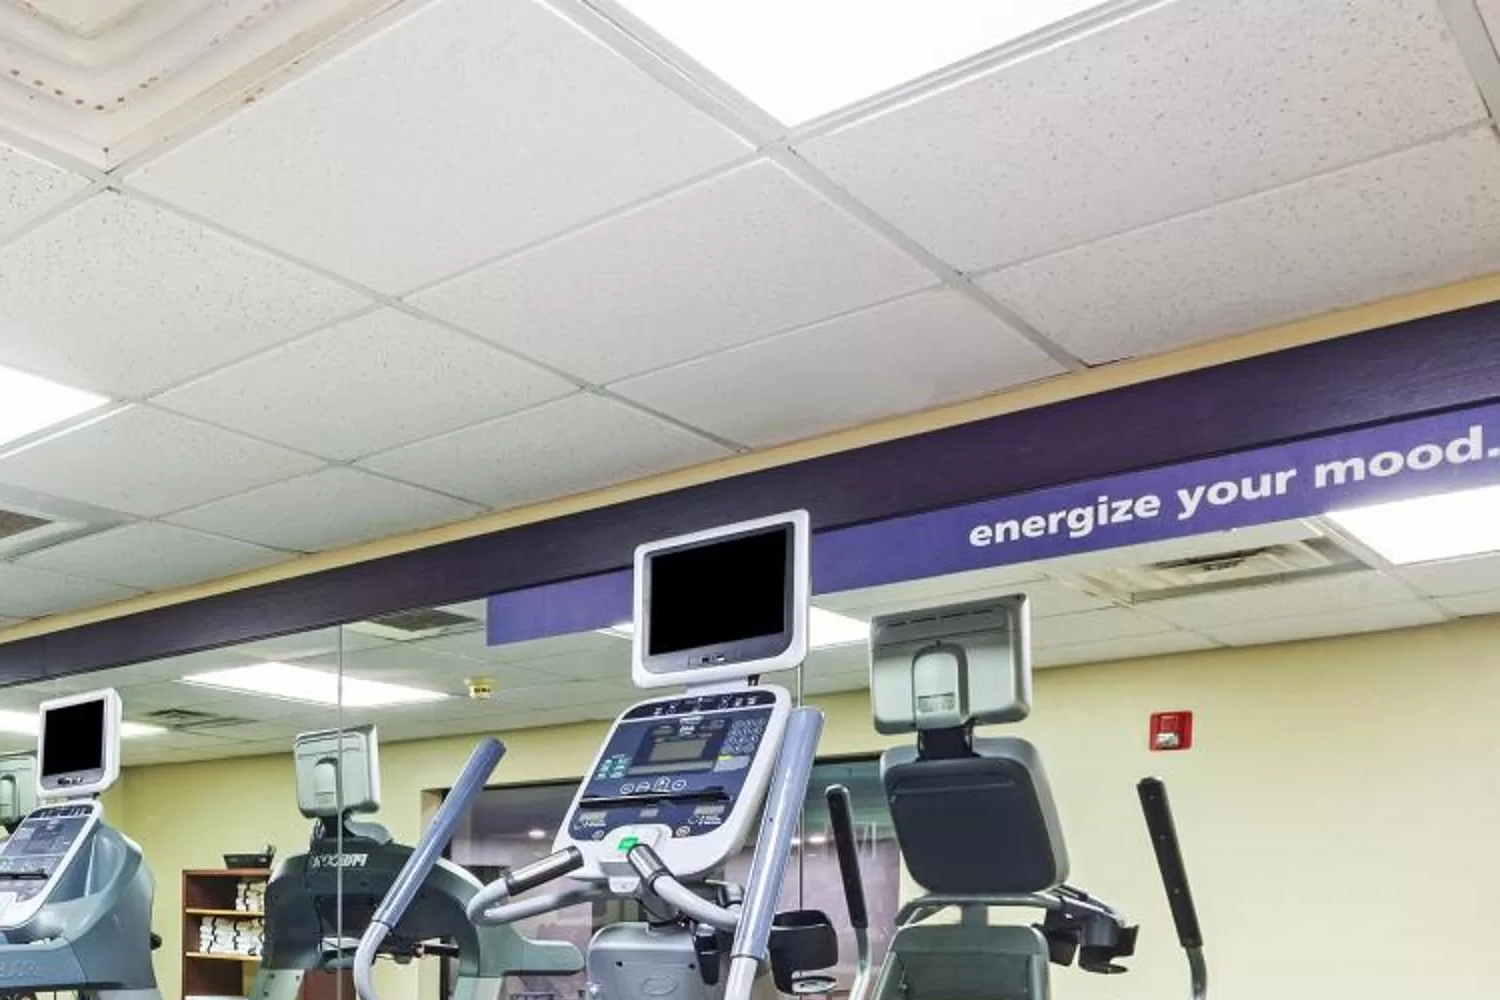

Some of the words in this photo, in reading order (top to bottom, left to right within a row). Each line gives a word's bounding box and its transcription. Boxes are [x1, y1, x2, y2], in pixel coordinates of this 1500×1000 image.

[969, 492, 1161, 548] energize
[1177, 468, 1298, 521] your
[1314, 425, 1500, 489] mood.
